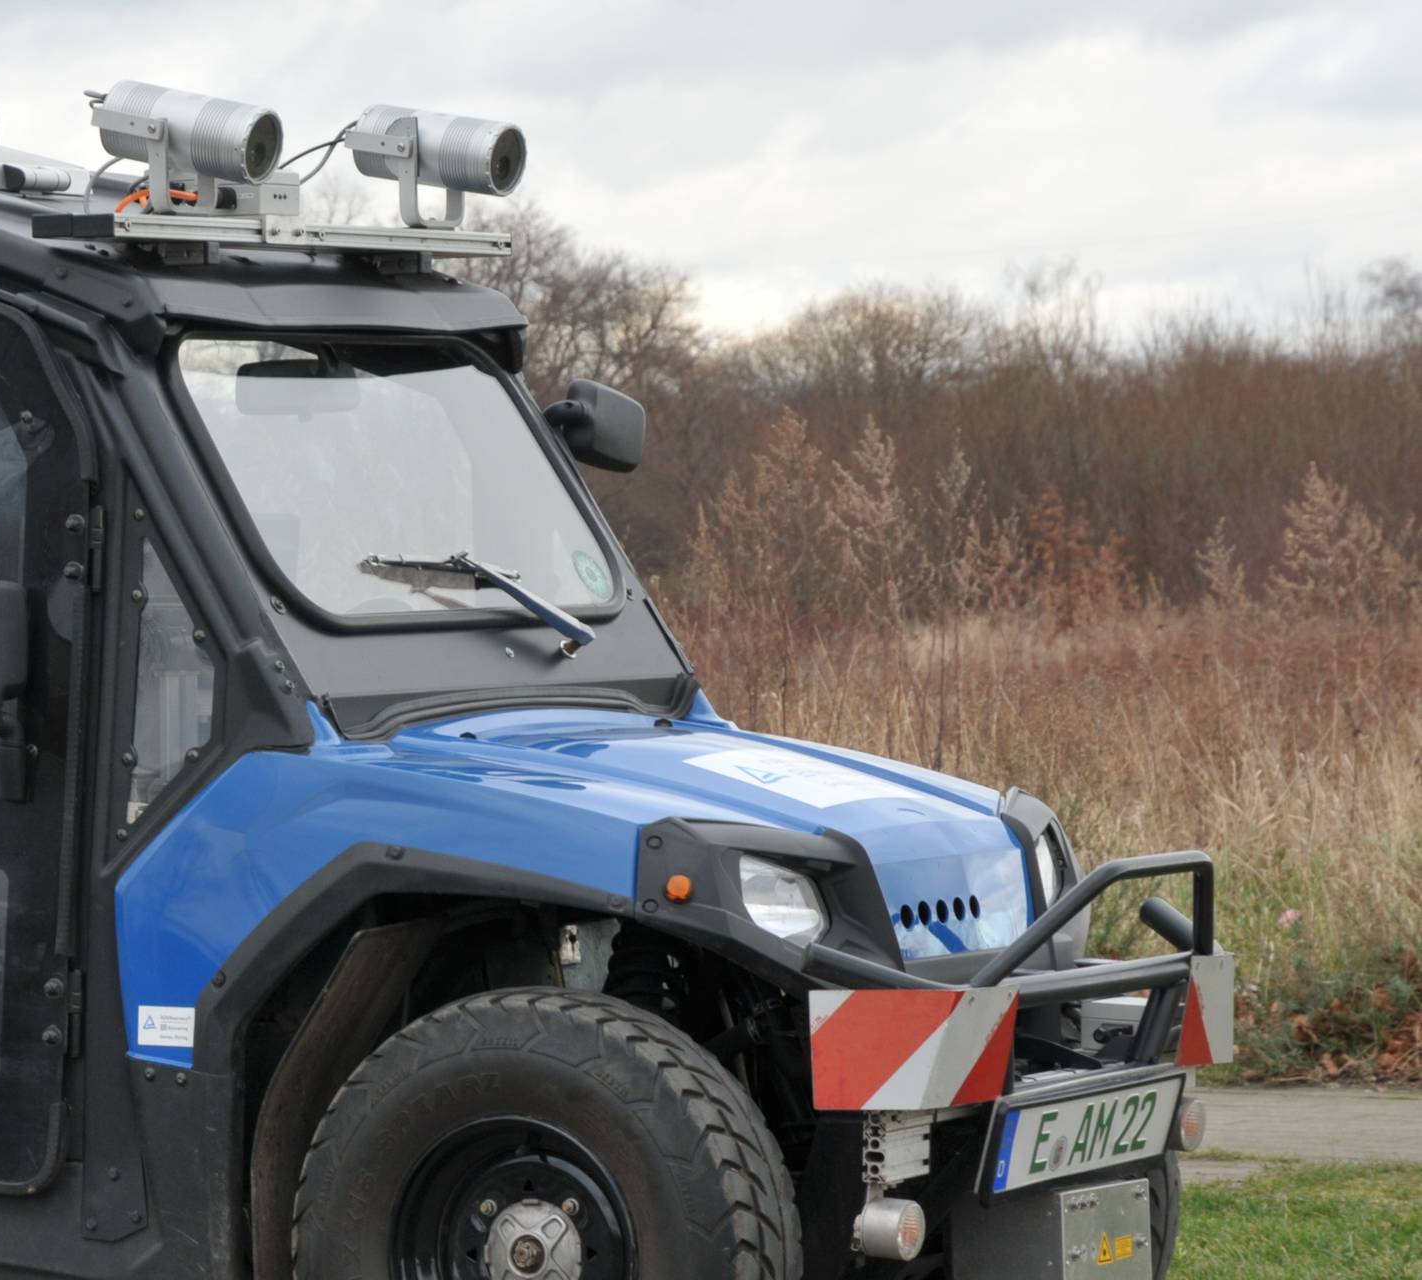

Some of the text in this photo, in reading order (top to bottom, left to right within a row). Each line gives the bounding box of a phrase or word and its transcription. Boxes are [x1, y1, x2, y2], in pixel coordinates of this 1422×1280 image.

[1029, 1090, 1158, 1174] E AM 22
[996, 1160, 1005, 1177] D
